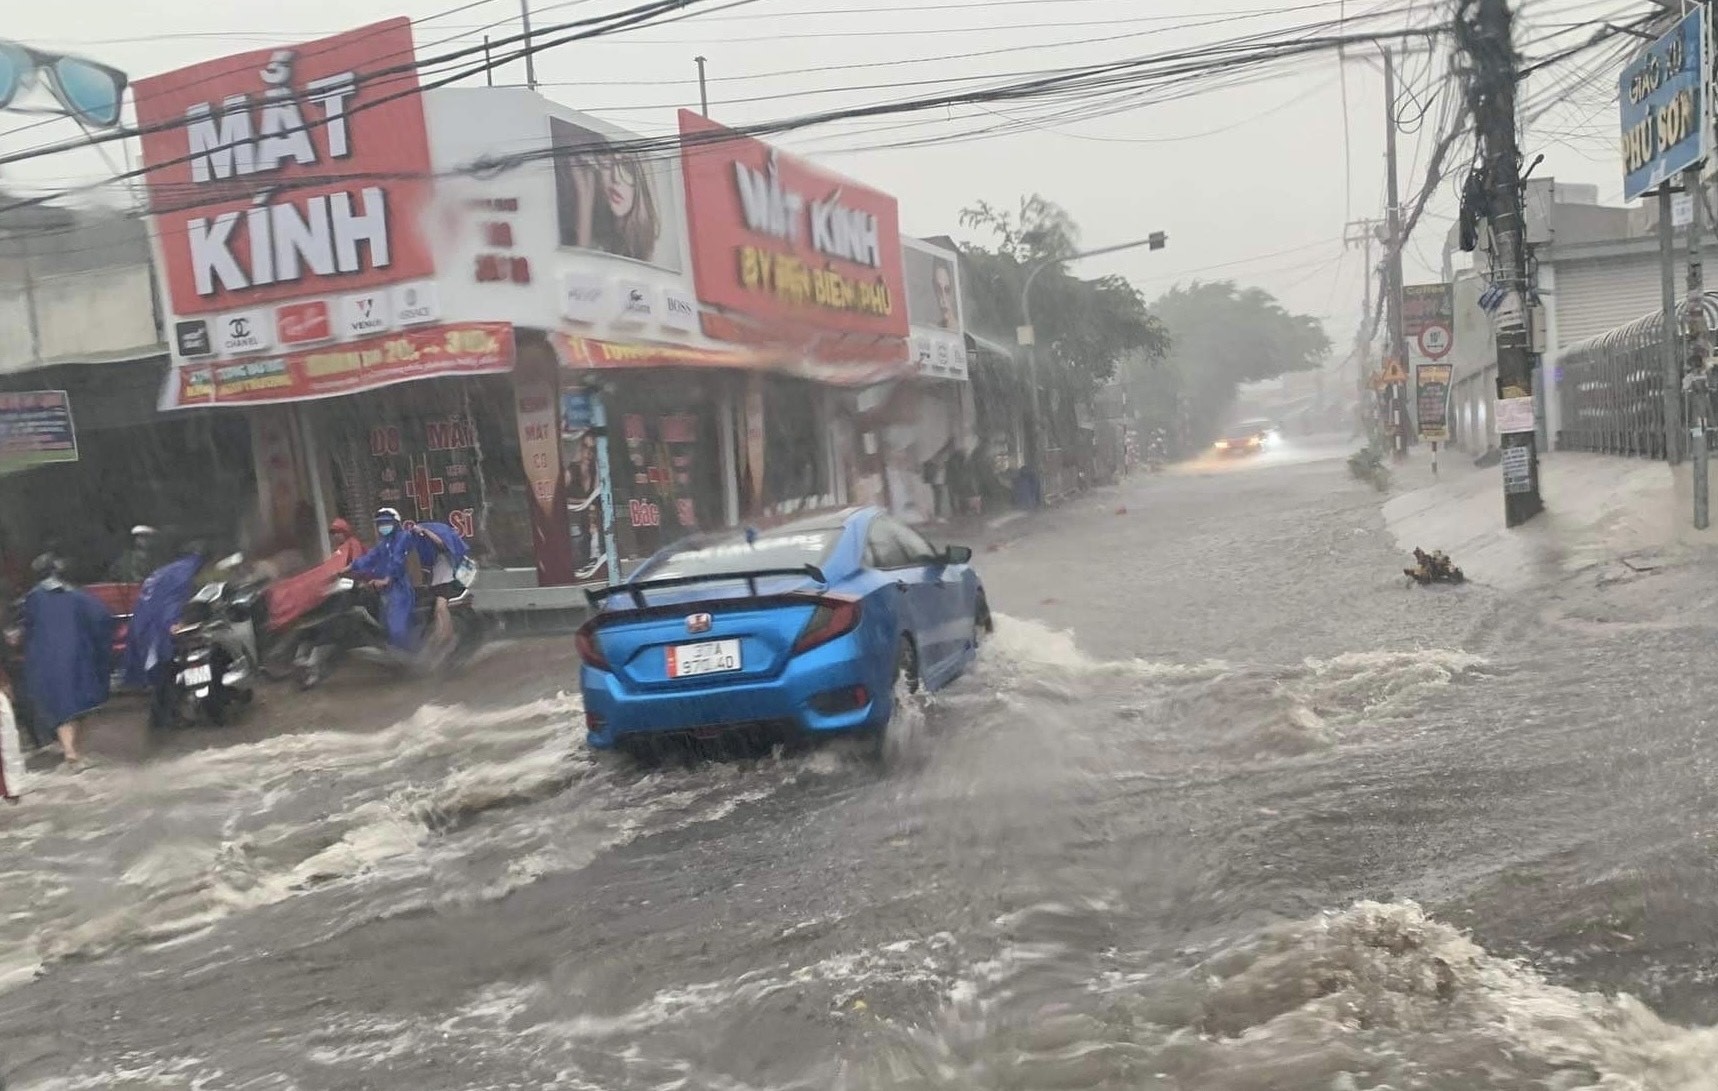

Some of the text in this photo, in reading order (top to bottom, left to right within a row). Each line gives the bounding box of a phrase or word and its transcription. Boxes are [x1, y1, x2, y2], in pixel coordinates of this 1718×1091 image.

[187, 50, 357, 183] MẮT
[187, 187, 390, 295] KÍNH
[811, 184, 881, 268] KÍNH
